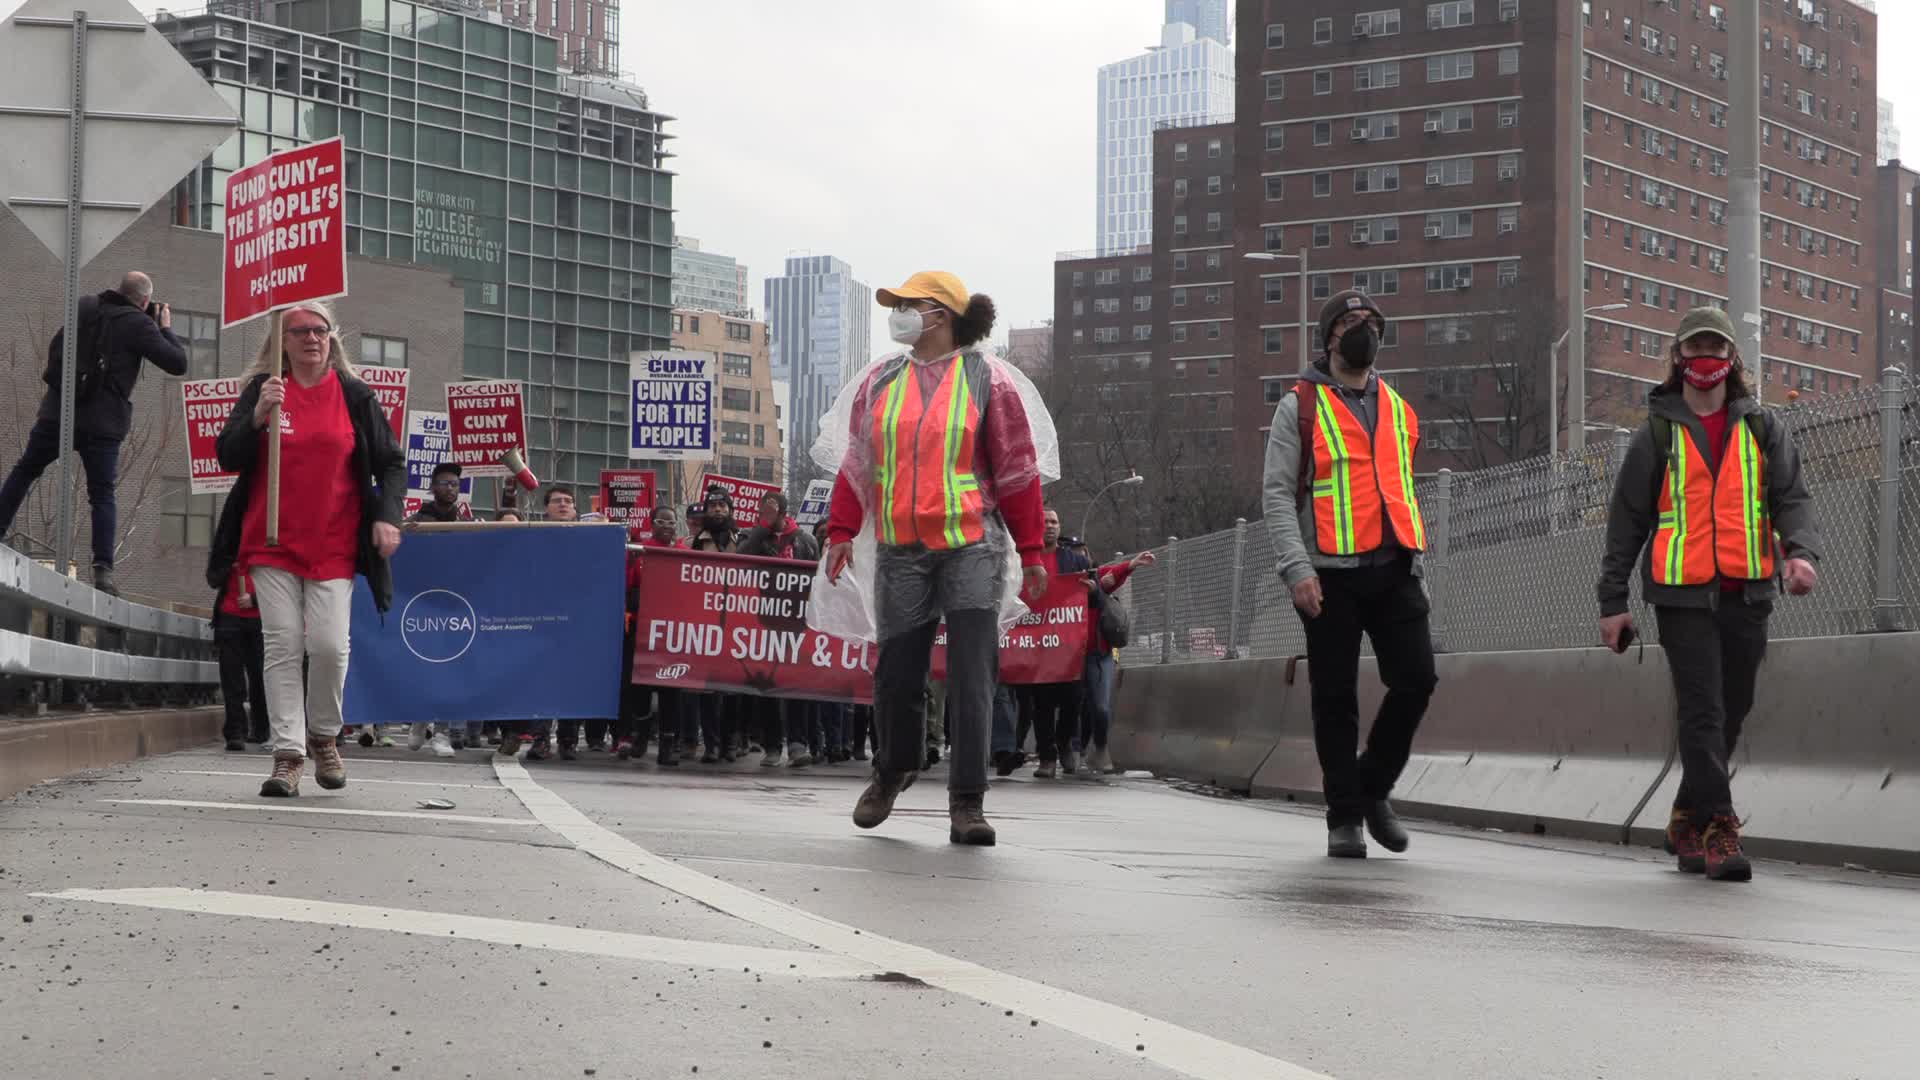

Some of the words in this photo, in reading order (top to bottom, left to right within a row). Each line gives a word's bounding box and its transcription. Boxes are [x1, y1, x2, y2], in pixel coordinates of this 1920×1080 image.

[231, 173, 266, 209] FUND
[435, 192, 456, 209] YORK
[228, 209, 254, 240] THE
[258, 183, 339, 228] PEOPLE'S
[415, 206, 475, 237] COLLEGE
[234, 216, 331, 269] UNIVERSITY
[415, 229, 502, 264] TECHNOLOGY
[648, 359, 706, 373] CUNY
[361, 368, 407, 383] CUNY
[184, 381, 238, 397] PSC-CU
[448, 384, 518, 395] PSC-CUNY
[636, 381, 685, 401] CUNY
[688, 381, 707, 402] IS
[454, 398, 497, 409] INVEST
[500, 396, 516, 407] IN
[188, 402, 235, 420] STUDE
[636, 403, 669, 423] FOR
[673, 404, 706, 424] THE
[198, 421, 225, 438] FAC
[423, 418, 447, 431] CU
[463, 415, 508, 429] CUNY
[423, 436, 449, 449] CUNY
[457, 433, 499, 445] INVEST
[502, 432, 517, 443] IN
[640, 426, 702, 446] PEOPLE
[409, 451, 439, 463] ABOUT
[440, 451, 451, 463] RA
[454, 450, 484, 463] NEW
[411, 464, 418, 475] &
[419, 477, 431, 489] JU
[738, 485, 768, 499] CUNY
[733, 496, 760, 511] EOPL
[604, 507, 628, 517] FUND
[629, 507, 652, 518] SUNY
[681, 563, 770, 590] ECONOMIC
[776, 572, 816, 593] OPP
[703, 591, 792, 617] ECONOMIC
[406, 617, 472, 632] SUNYSA
[505, 624, 533, 632] Assembly
[648, 619, 723, 656] FUND
[731, 627, 806, 664] SUNY
[812, 634, 832, 668] &
[1019, 636, 1035, 648] AFL
[1042, 635, 1060, 647] CIO
